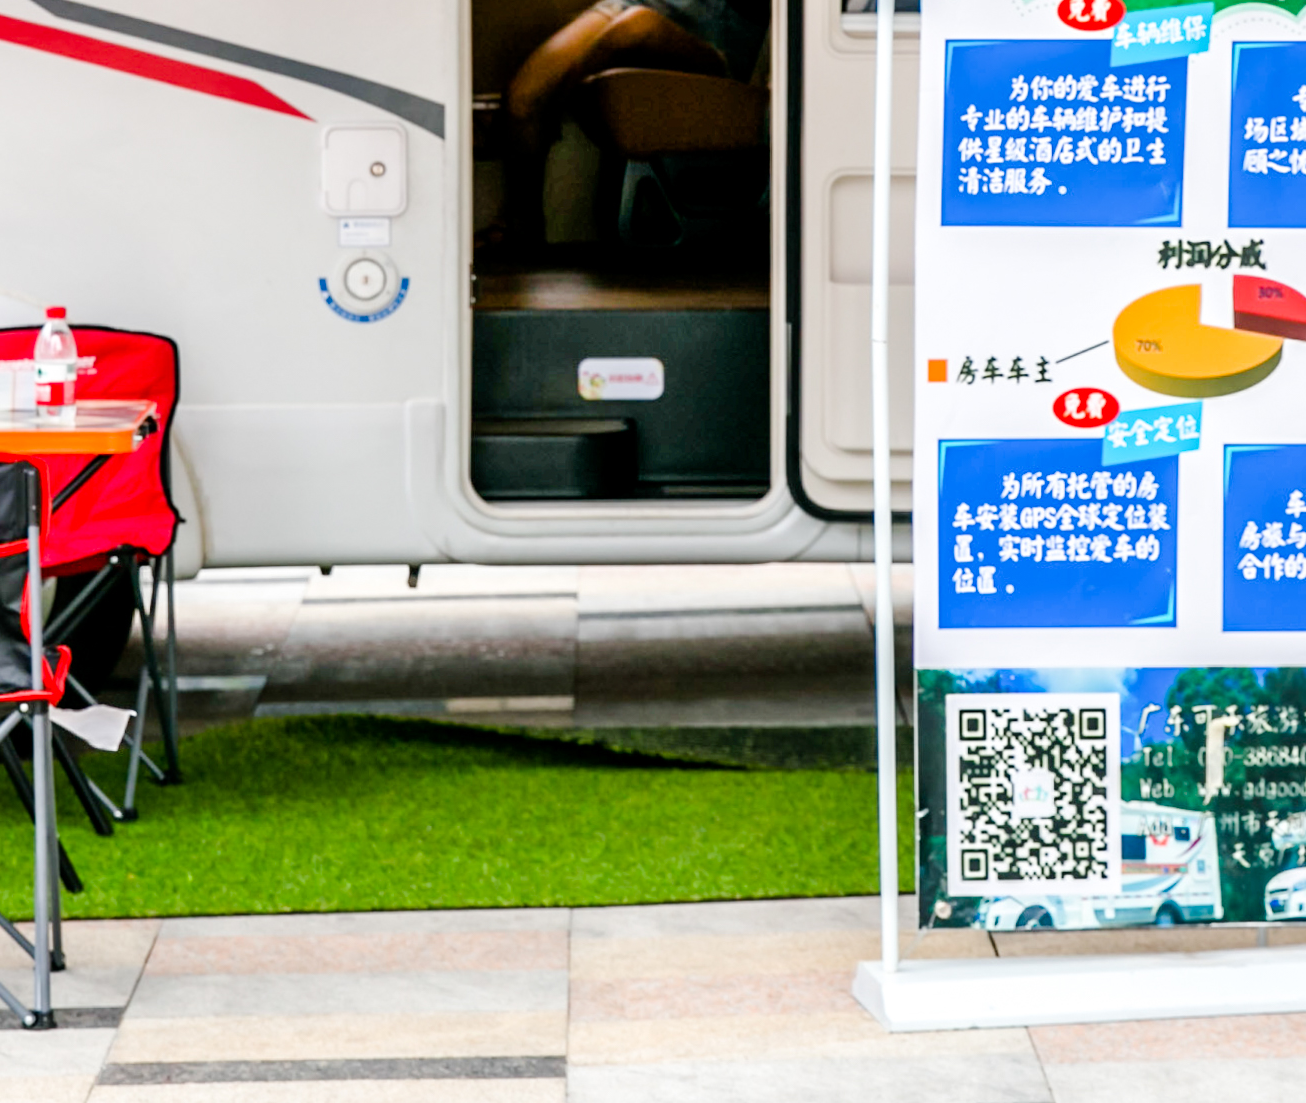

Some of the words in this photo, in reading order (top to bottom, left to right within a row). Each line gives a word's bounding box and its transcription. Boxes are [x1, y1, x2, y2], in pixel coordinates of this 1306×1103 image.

[1114, 14, 1207, 49] 车辆维保
[1010, 74, 1171, 103] 为你的爱车进行
[960, 104, 1169, 133] 专业的车辆维护和提
[958, 136, 1167, 165] 供星级酒店式的卫生
[1157, 238, 1268, 271] 利润分成
[1136, 339, 1162, 354] 70%
[956, 355, 1054, 385] 房车车主
[1063, 392, 1107, 419] 免费
[1106, 414, 1200, 449] 安全定位
[1000, 471, 1160, 501] 为所有托管的房
